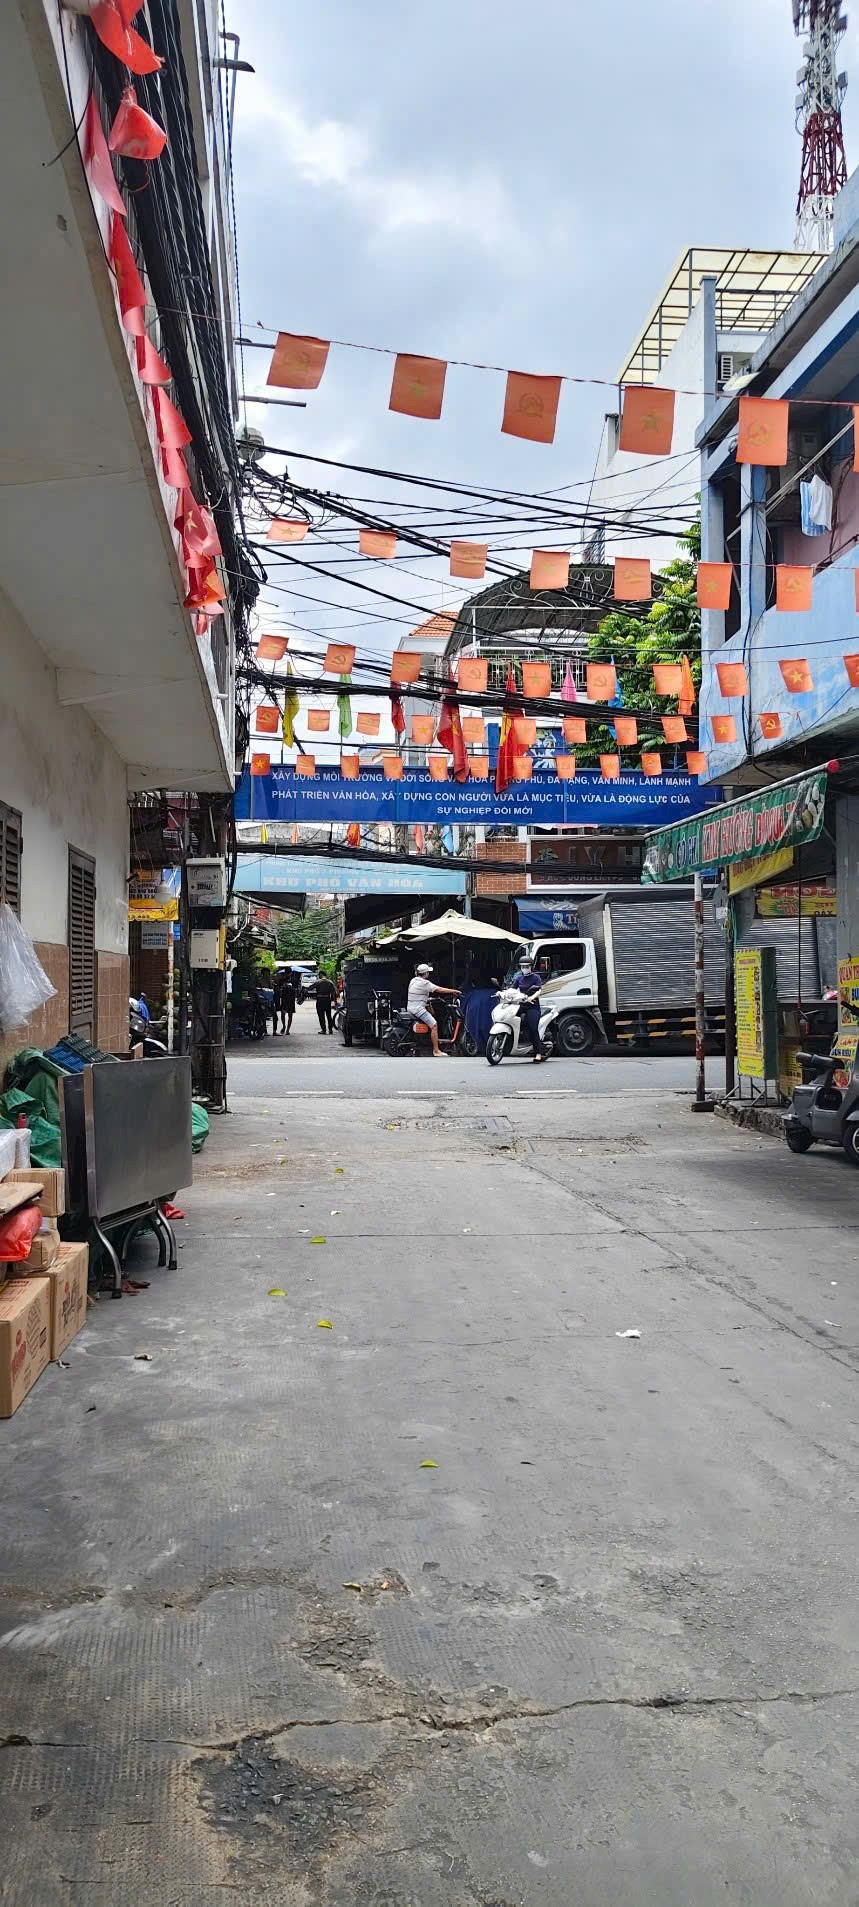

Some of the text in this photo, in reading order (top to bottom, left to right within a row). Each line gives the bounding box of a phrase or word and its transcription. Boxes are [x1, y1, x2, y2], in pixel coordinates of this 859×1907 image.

[272, 771, 291, 780] XÂY
[323, 771, 340, 781] MÔI
[665, 777, 691, 787] MẠNH
[272, 789, 298, 798] PHÁT
[332, 790, 352, 799] VĂN
[404, 792, 432, 802] DỰNG
[435, 792, 455, 801] CON
[459, 791, 491, 801] NGƯỜI
[517, 791, 529, 801] LÀ
[531, 793, 552, 803] MỤC
[581, 792, 601, 802] VỪA
[604, 793, 616, 802] LÀ
[618, 794, 646, 805] ĐỘNG
[649, 795, 668, 804] LỰC
[671, 794, 690, 803] CỦA
[437, 806, 452, 815] SỰ
[454, 807, 491, 815] NGHIỆP
[514, 806, 533, 815] MỚI
